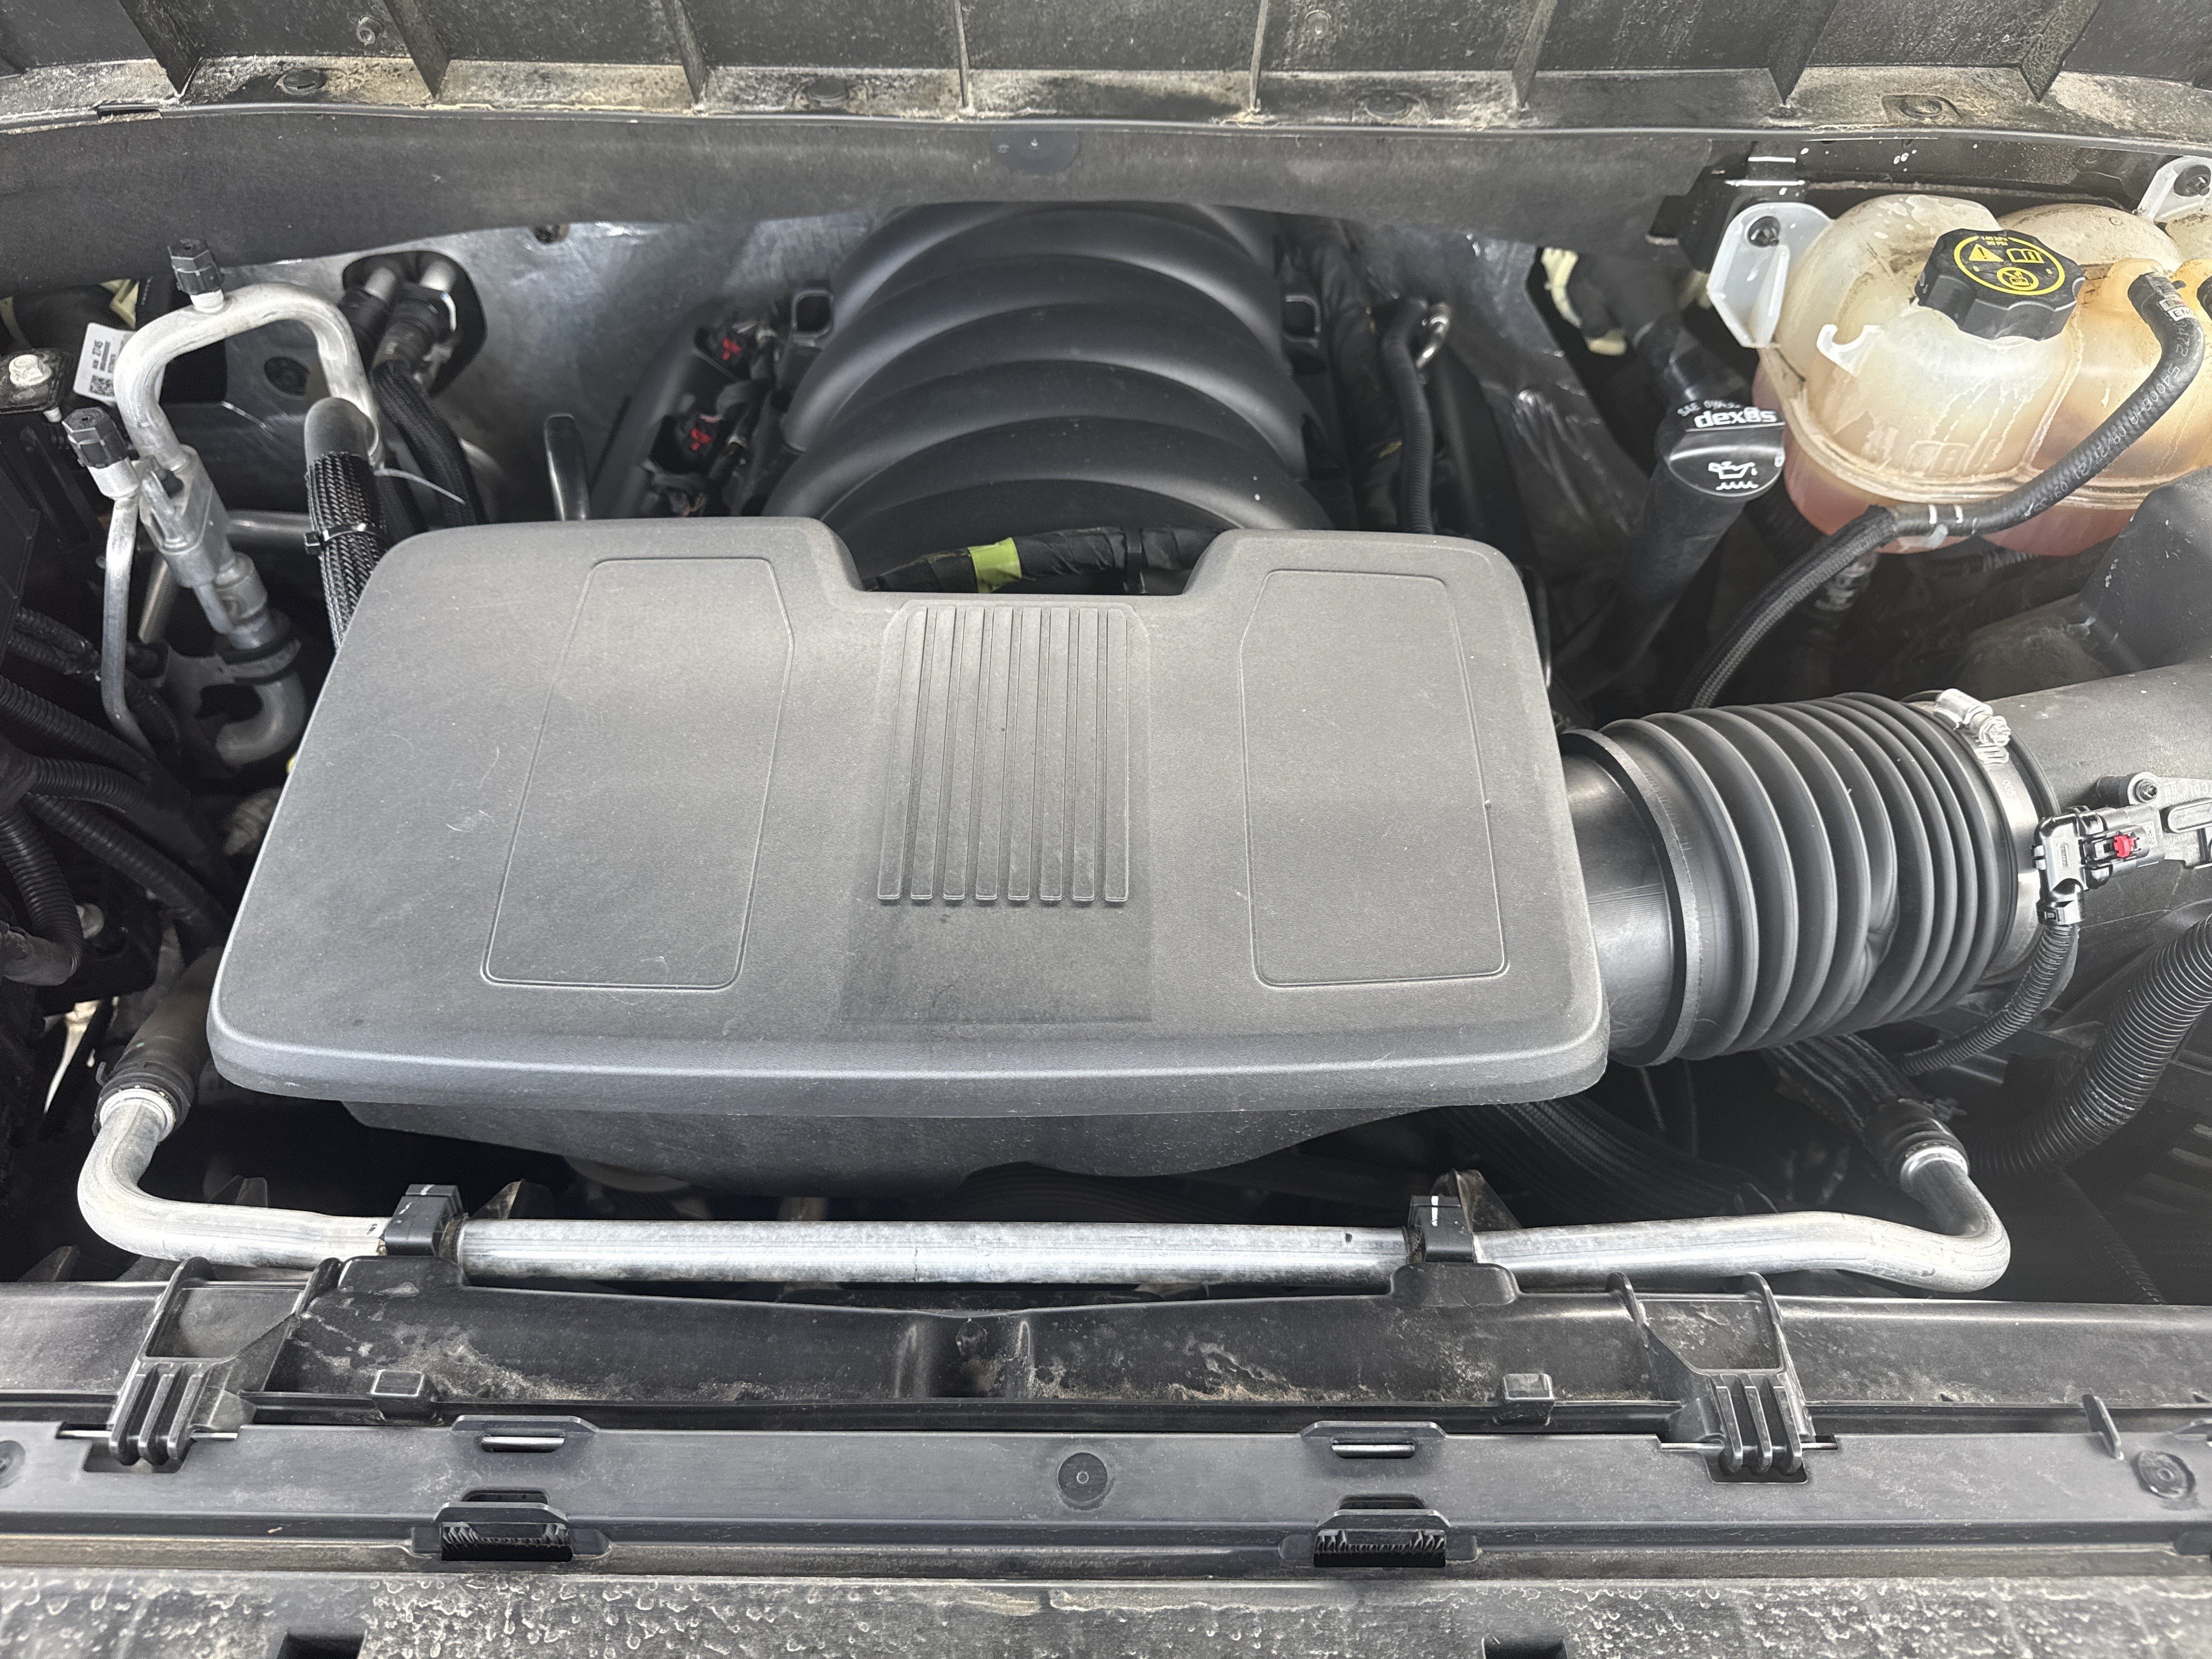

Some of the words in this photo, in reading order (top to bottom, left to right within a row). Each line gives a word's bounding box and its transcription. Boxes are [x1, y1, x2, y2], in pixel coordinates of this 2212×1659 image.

[1677, 402, 1701, 416] SAE
[1694, 407, 1777, 428] dexos
[2163, 783, 2178, 797] GM
